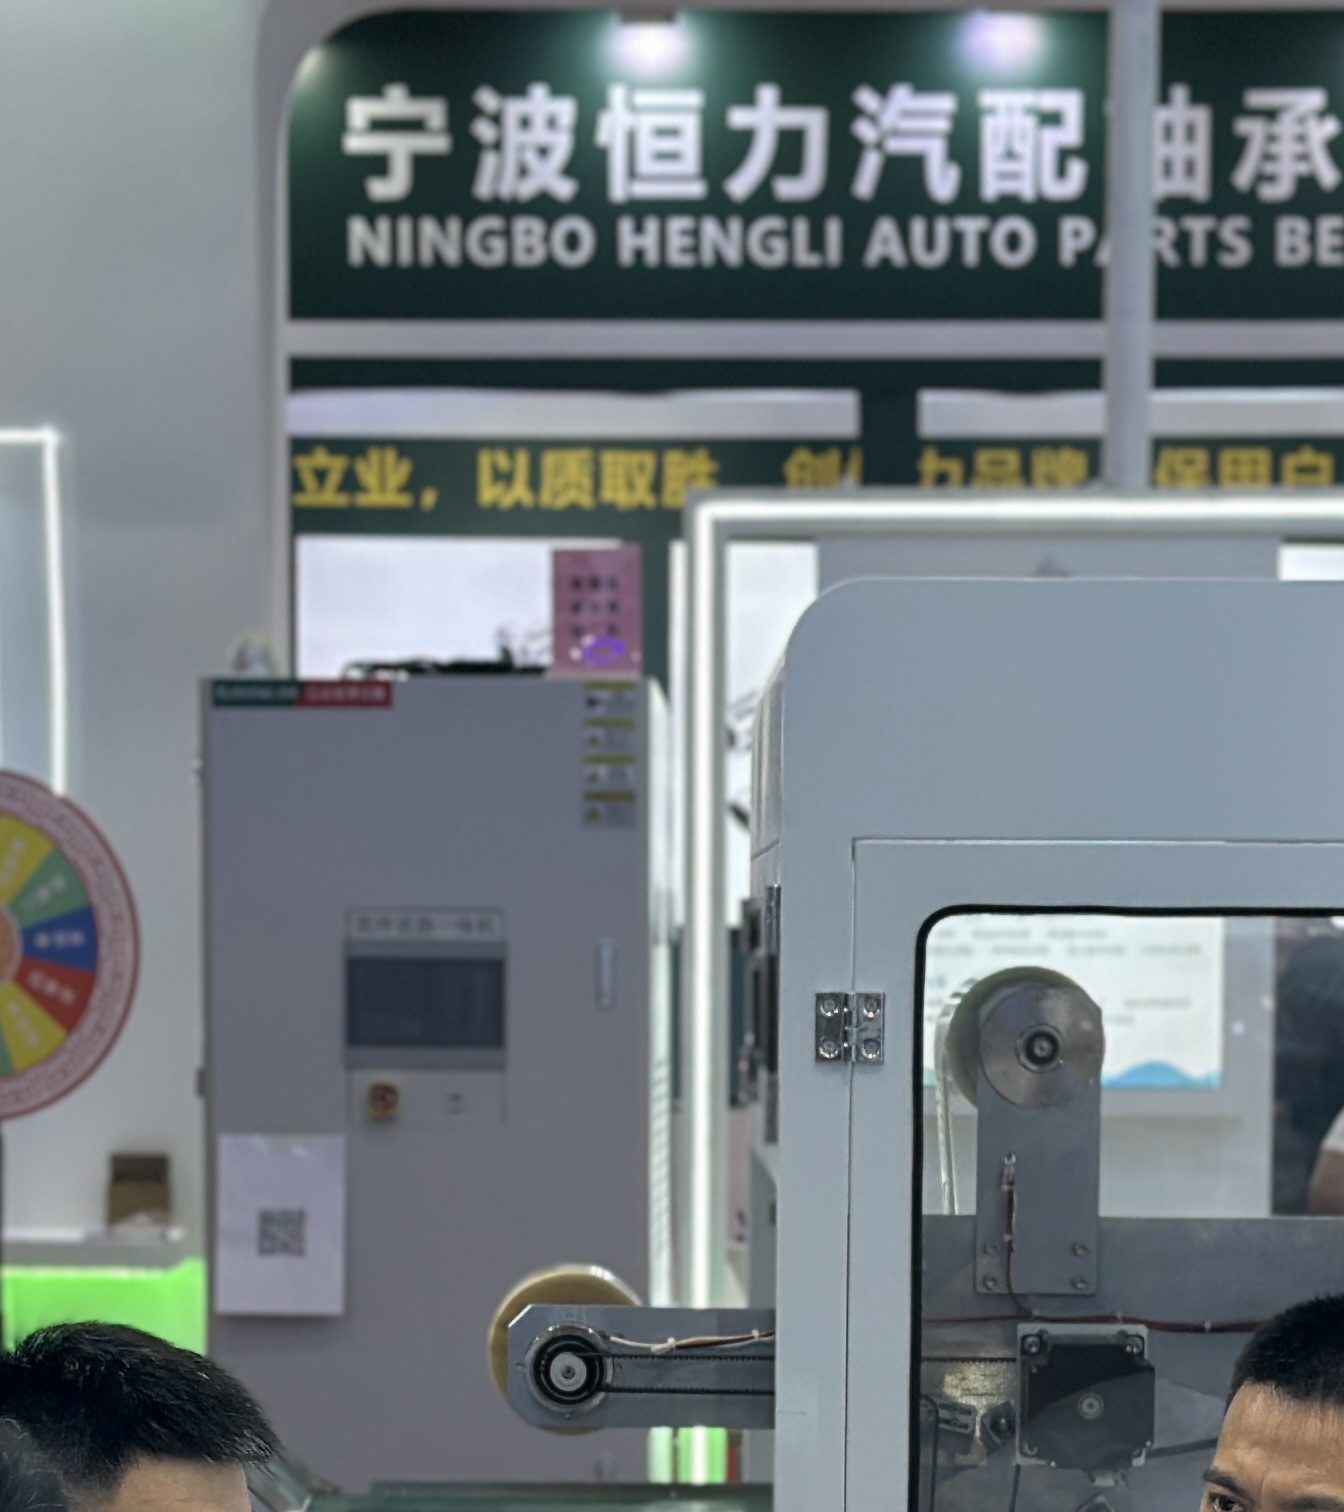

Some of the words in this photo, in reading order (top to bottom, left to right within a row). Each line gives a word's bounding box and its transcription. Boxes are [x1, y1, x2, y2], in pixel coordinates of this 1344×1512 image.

[347, 215, 597, 269] NINGBO
[617, 214, 843, 269] HENGLI
[863, 214, 1038, 269] AUTO
[1059, 215, 1254, 268] PRTS
